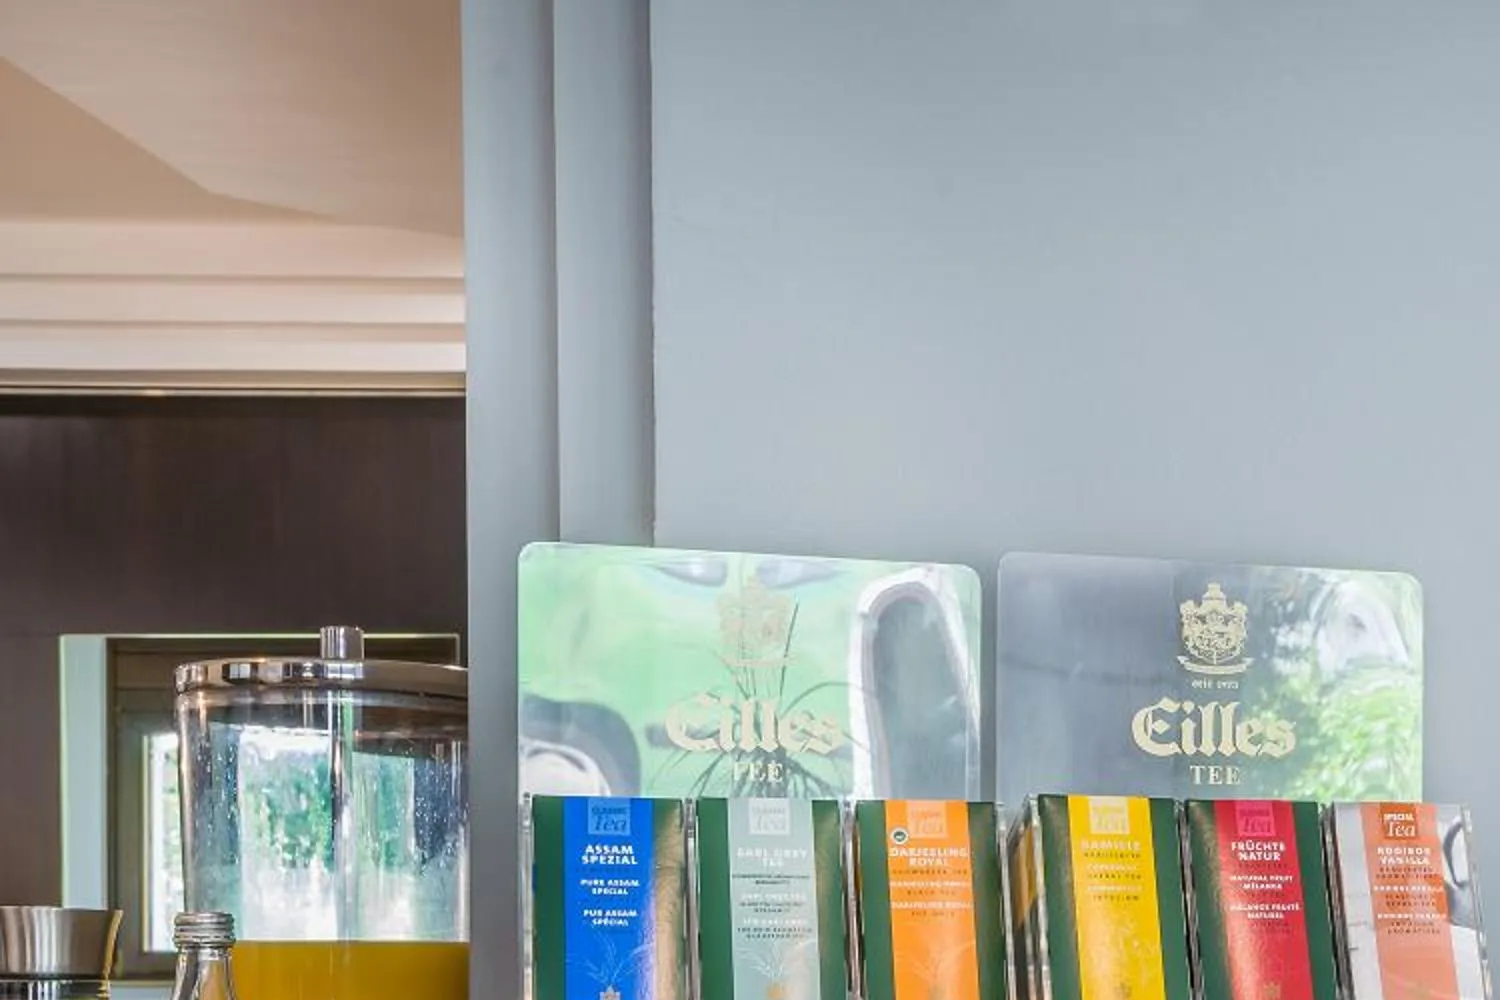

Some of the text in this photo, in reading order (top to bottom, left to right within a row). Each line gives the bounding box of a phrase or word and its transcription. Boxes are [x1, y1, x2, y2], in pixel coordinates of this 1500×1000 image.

[665, 689, 844, 755] Eilles
[1131, 696, 1298, 758] Eilles
[1189, 765, 1241, 785] TEE
[1387, 821, 1416, 837] Tea
[584, 843, 634, 855] ASSAM
[1231, 840, 1286, 852] FRÜCHTE
[1377, 847, 1431, 855] ROOIBOS
[888, 847, 968, 857] DARJEELING
[1238, 852, 1281, 861] NATUR
[581, 855, 638, 865] SPEZIAL
[908, 857, 949, 867] ROYAL
[580, 879, 640, 887] PURE ASSAM
[583, 908, 638, 917] PUR ASSAM
